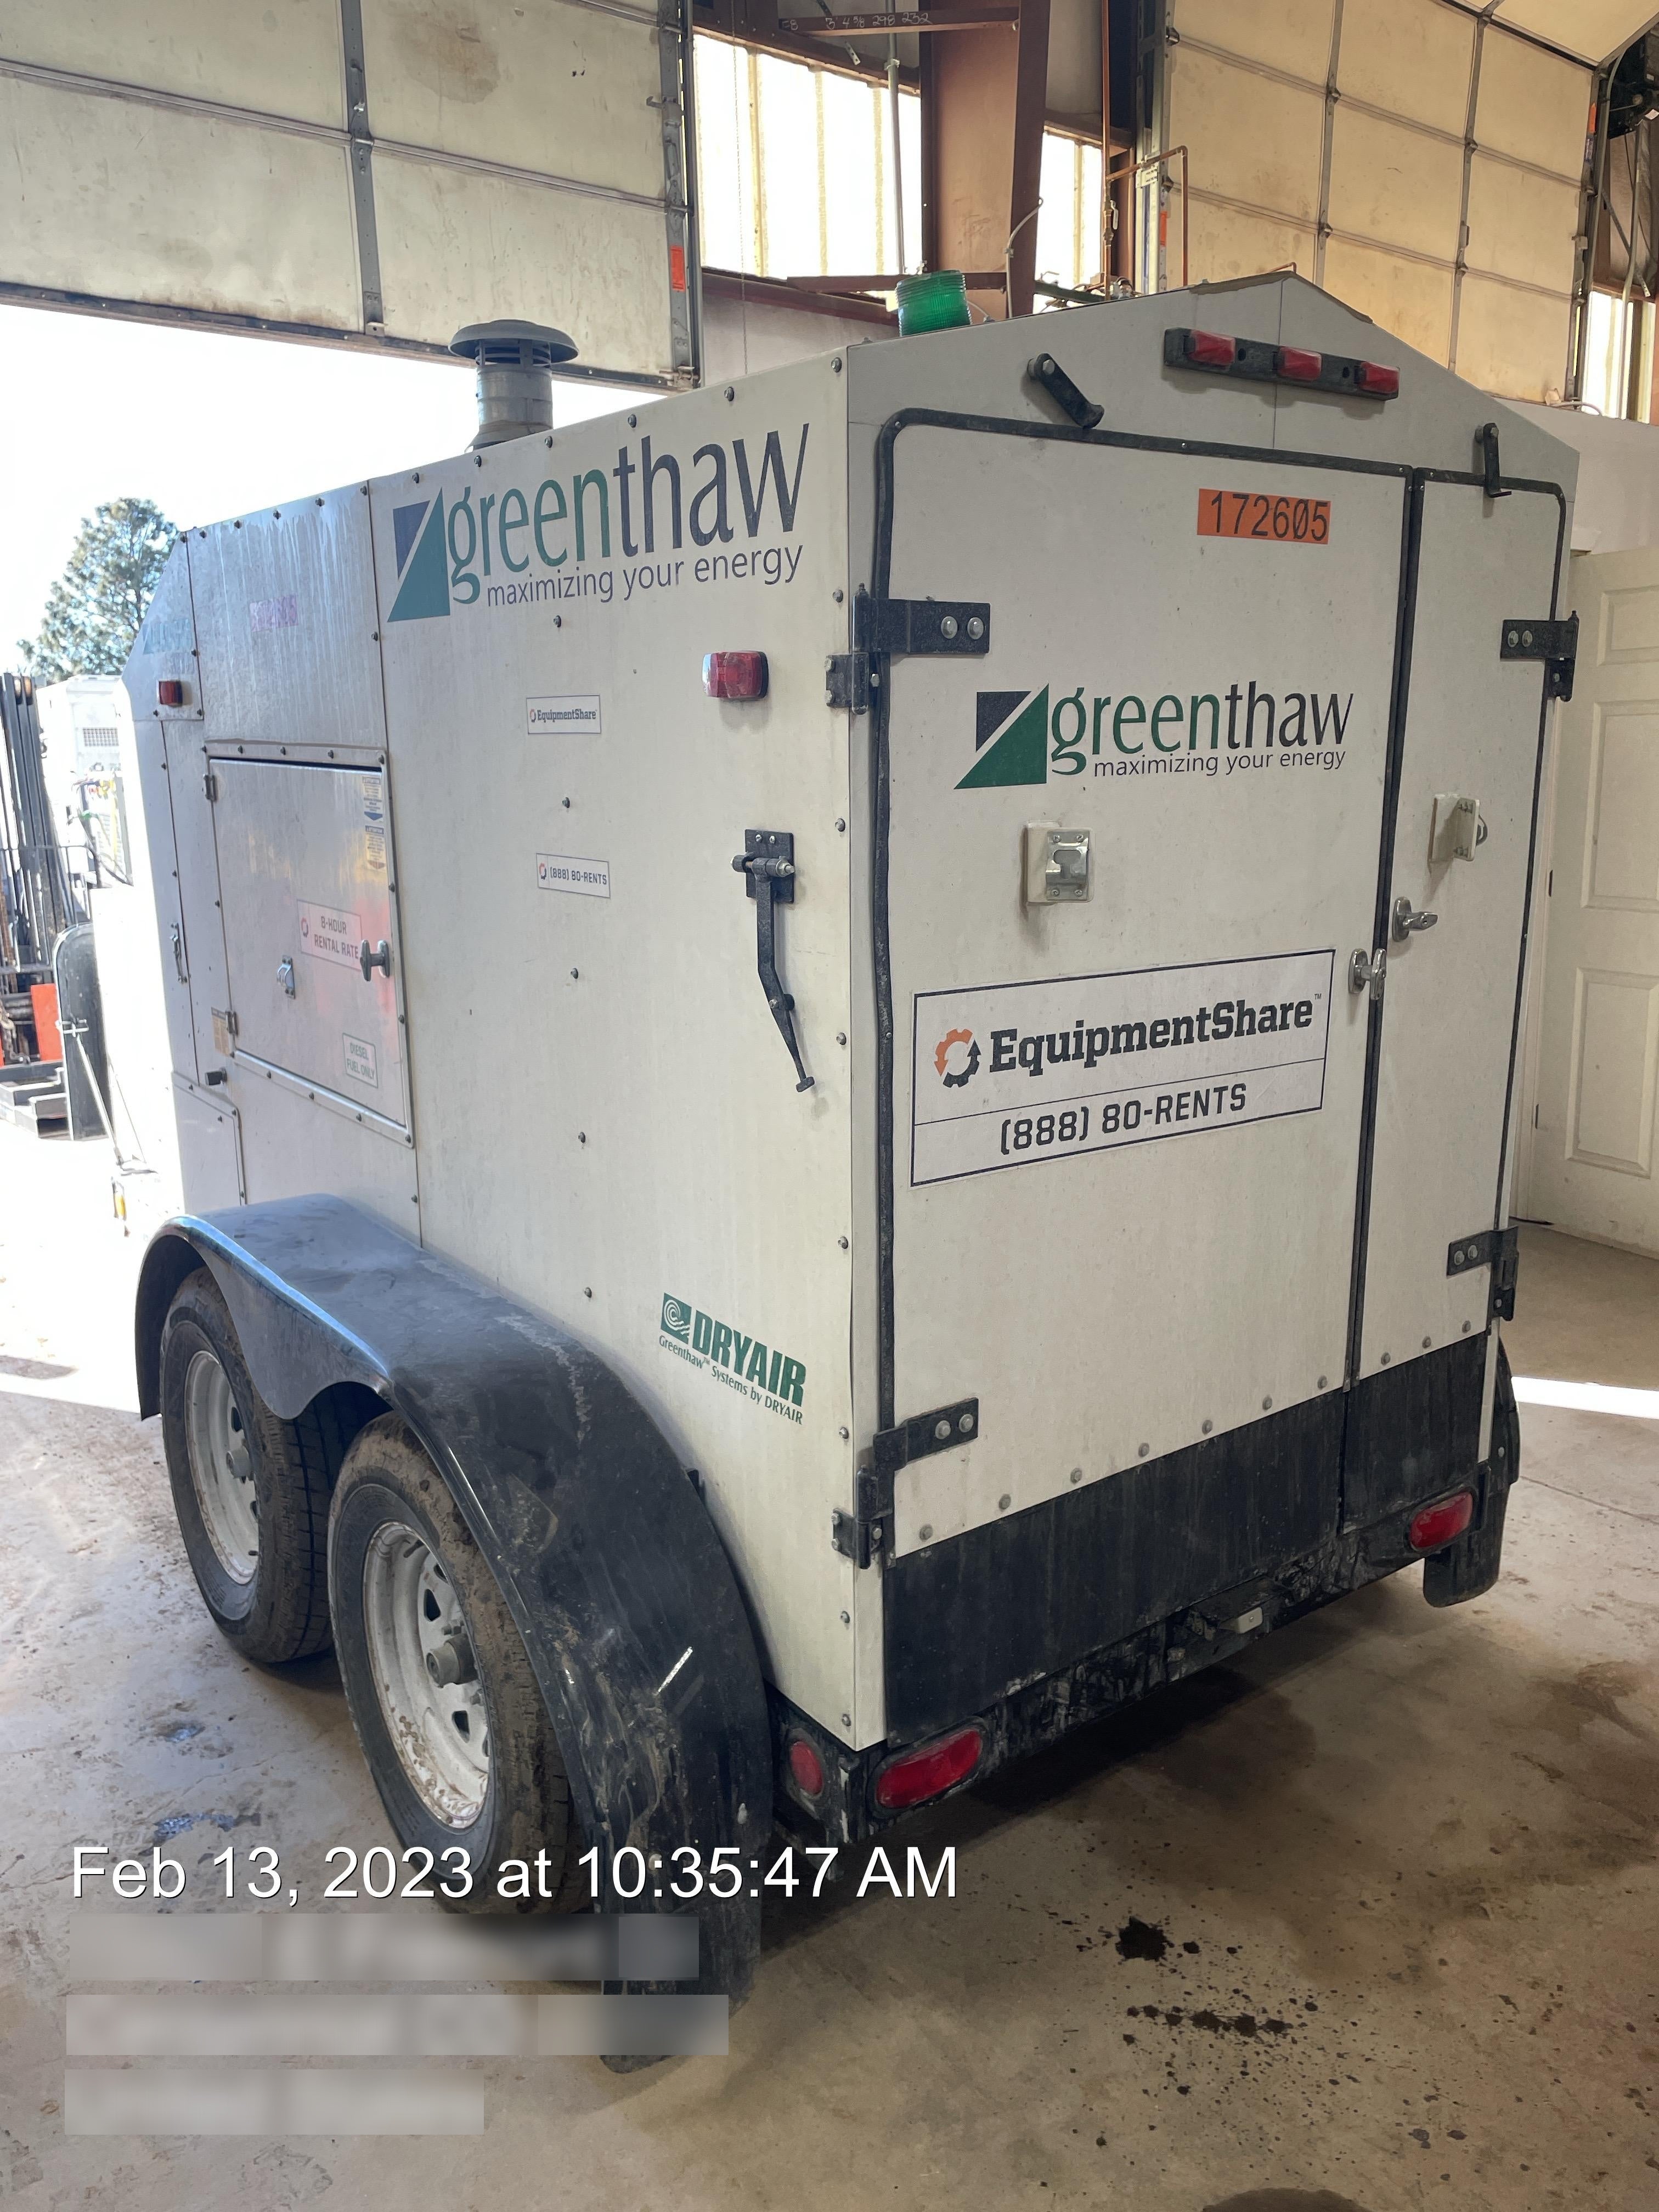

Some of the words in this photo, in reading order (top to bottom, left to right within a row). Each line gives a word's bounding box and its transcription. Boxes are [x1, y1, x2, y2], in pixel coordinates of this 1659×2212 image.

[872, 14, 896, 26] 298
[901, 12, 933, 25] 232
[448, 424, 809, 604] greenthaw
[1211, 491, 1328, 541] 172605
[488, 567, 614, 607] maximizing
[623, 560, 685, 601] your
[694, 545, 803, 585] energy
[1051, 681, 1355, 776] greenthaw
[1094, 752, 1218, 777] maximizing
[1226, 754, 1274, 775] your
[1280, 750, 1346, 770] energy
[550, 867, 569, 881] (888)
[571, 870, 607, 885] 80-RENTS
[321, 916, 347, 935] 8-HOUR
[314, 934, 340, 953] RENTAL
[341, 942, 359, 960] RATE
[347, 1058, 360, 1074] FUEL
[360, 1064, 375, 1080] ONLY
[350, 1042, 369, 1060] DIESEL
[1001, 1107, 1089, 1155] (888)
[1102, 1083, 1246, 1134] 80-RENTS
[692, 1310, 806, 1407] DRYAIR
[711, 1365, 748, 1396] Systems
[751, 1387, 762, 1404] by
[765, 1395, 803, 1425] DRYAIR
